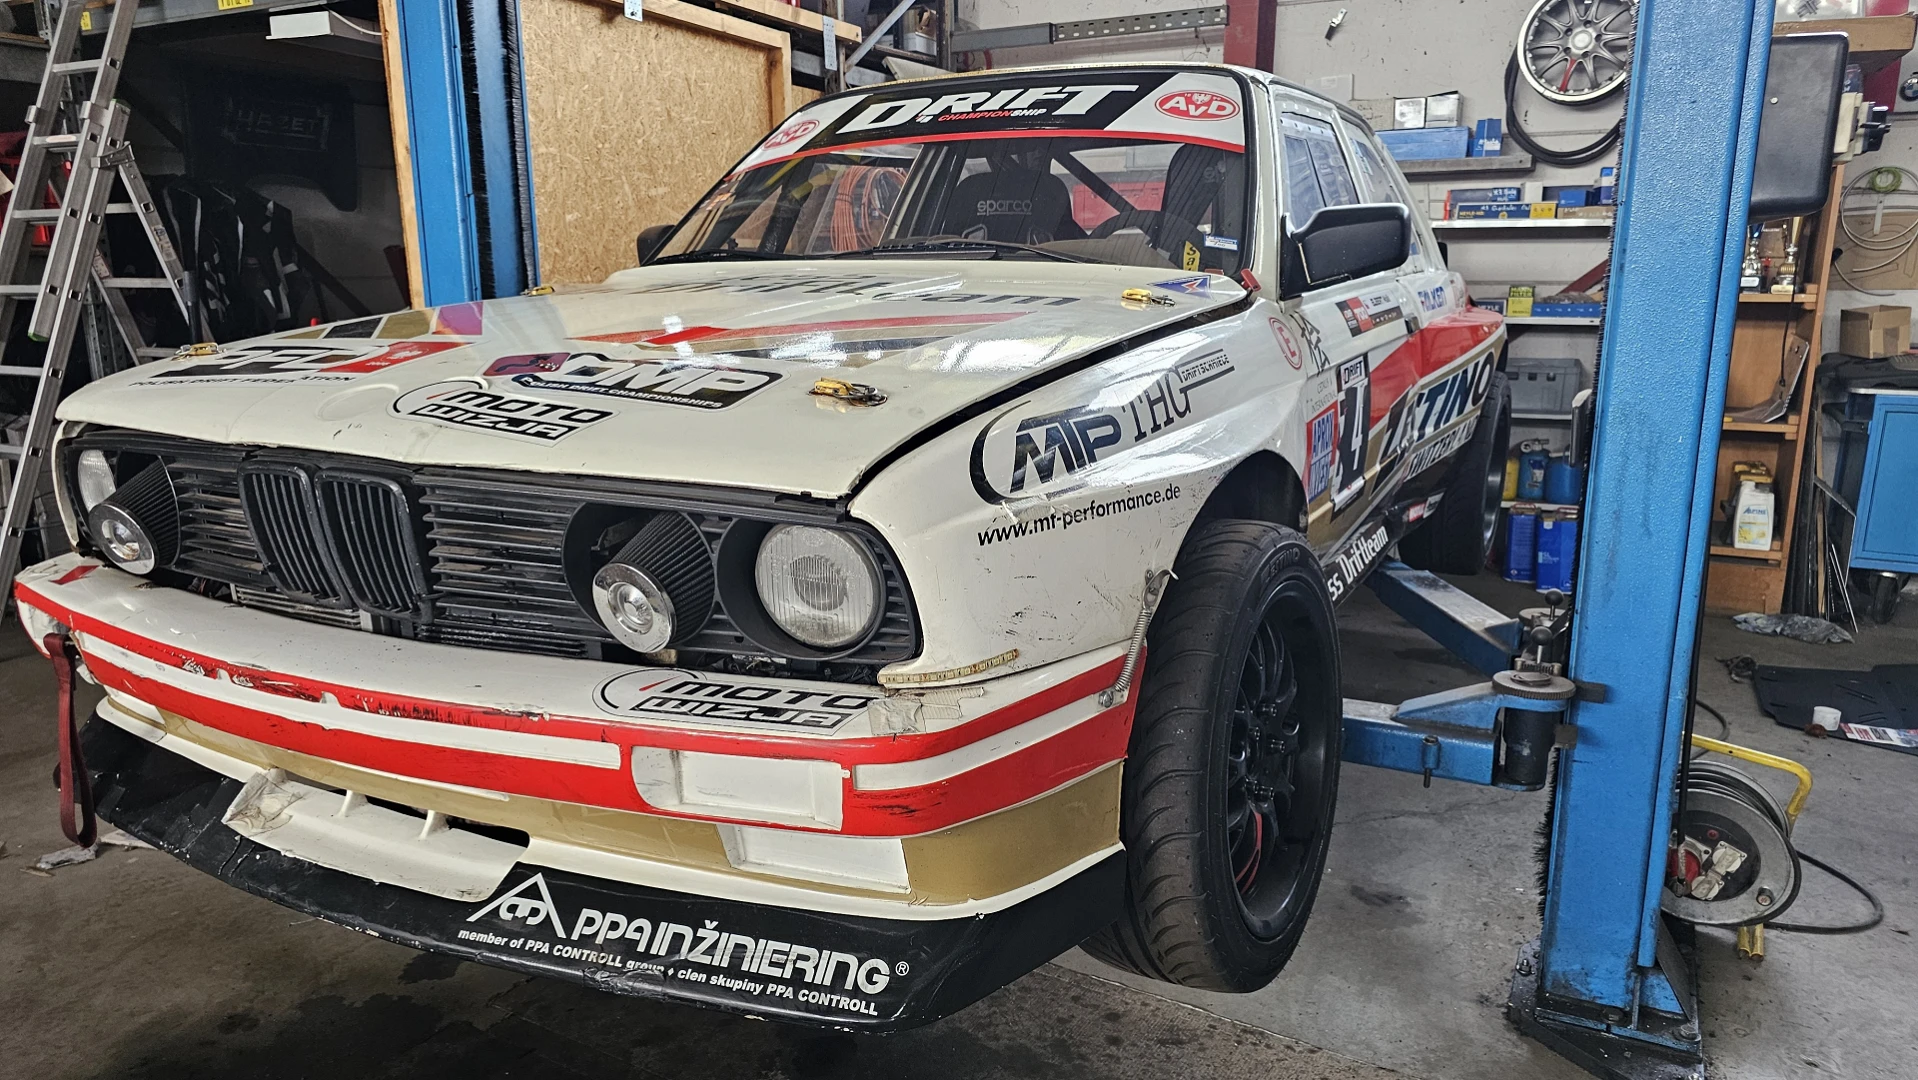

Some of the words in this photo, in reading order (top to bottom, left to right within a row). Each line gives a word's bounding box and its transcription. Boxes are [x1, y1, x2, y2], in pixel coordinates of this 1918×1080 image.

[836, 85, 1138, 134] DRIFT
[938, 108, 1047, 123] CHAMPIONSHIP
[977, 200, 1032, 216] sparco
[446, 391, 613, 424] MOTO
[521, 377, 568, 389] POLISH
[569, 385, 608, 394] DRIFT
[608, 389, 724, 408] CHAMPIONSHIPS
[1335, 526, 1389, 584] Driftteam
[662, 680, 879, 710] MOTO
[457, 929, 506, 946] member
[510, 937, 524, 950] of
[525, 940, 549, 954] PPA
[552, 944, 623, 968] CONTROLL
[709, 973, 764, 995] skupiny
[766, 984, 794, 999] PPA
[797, 989, 878, 1016] CONTROLL
